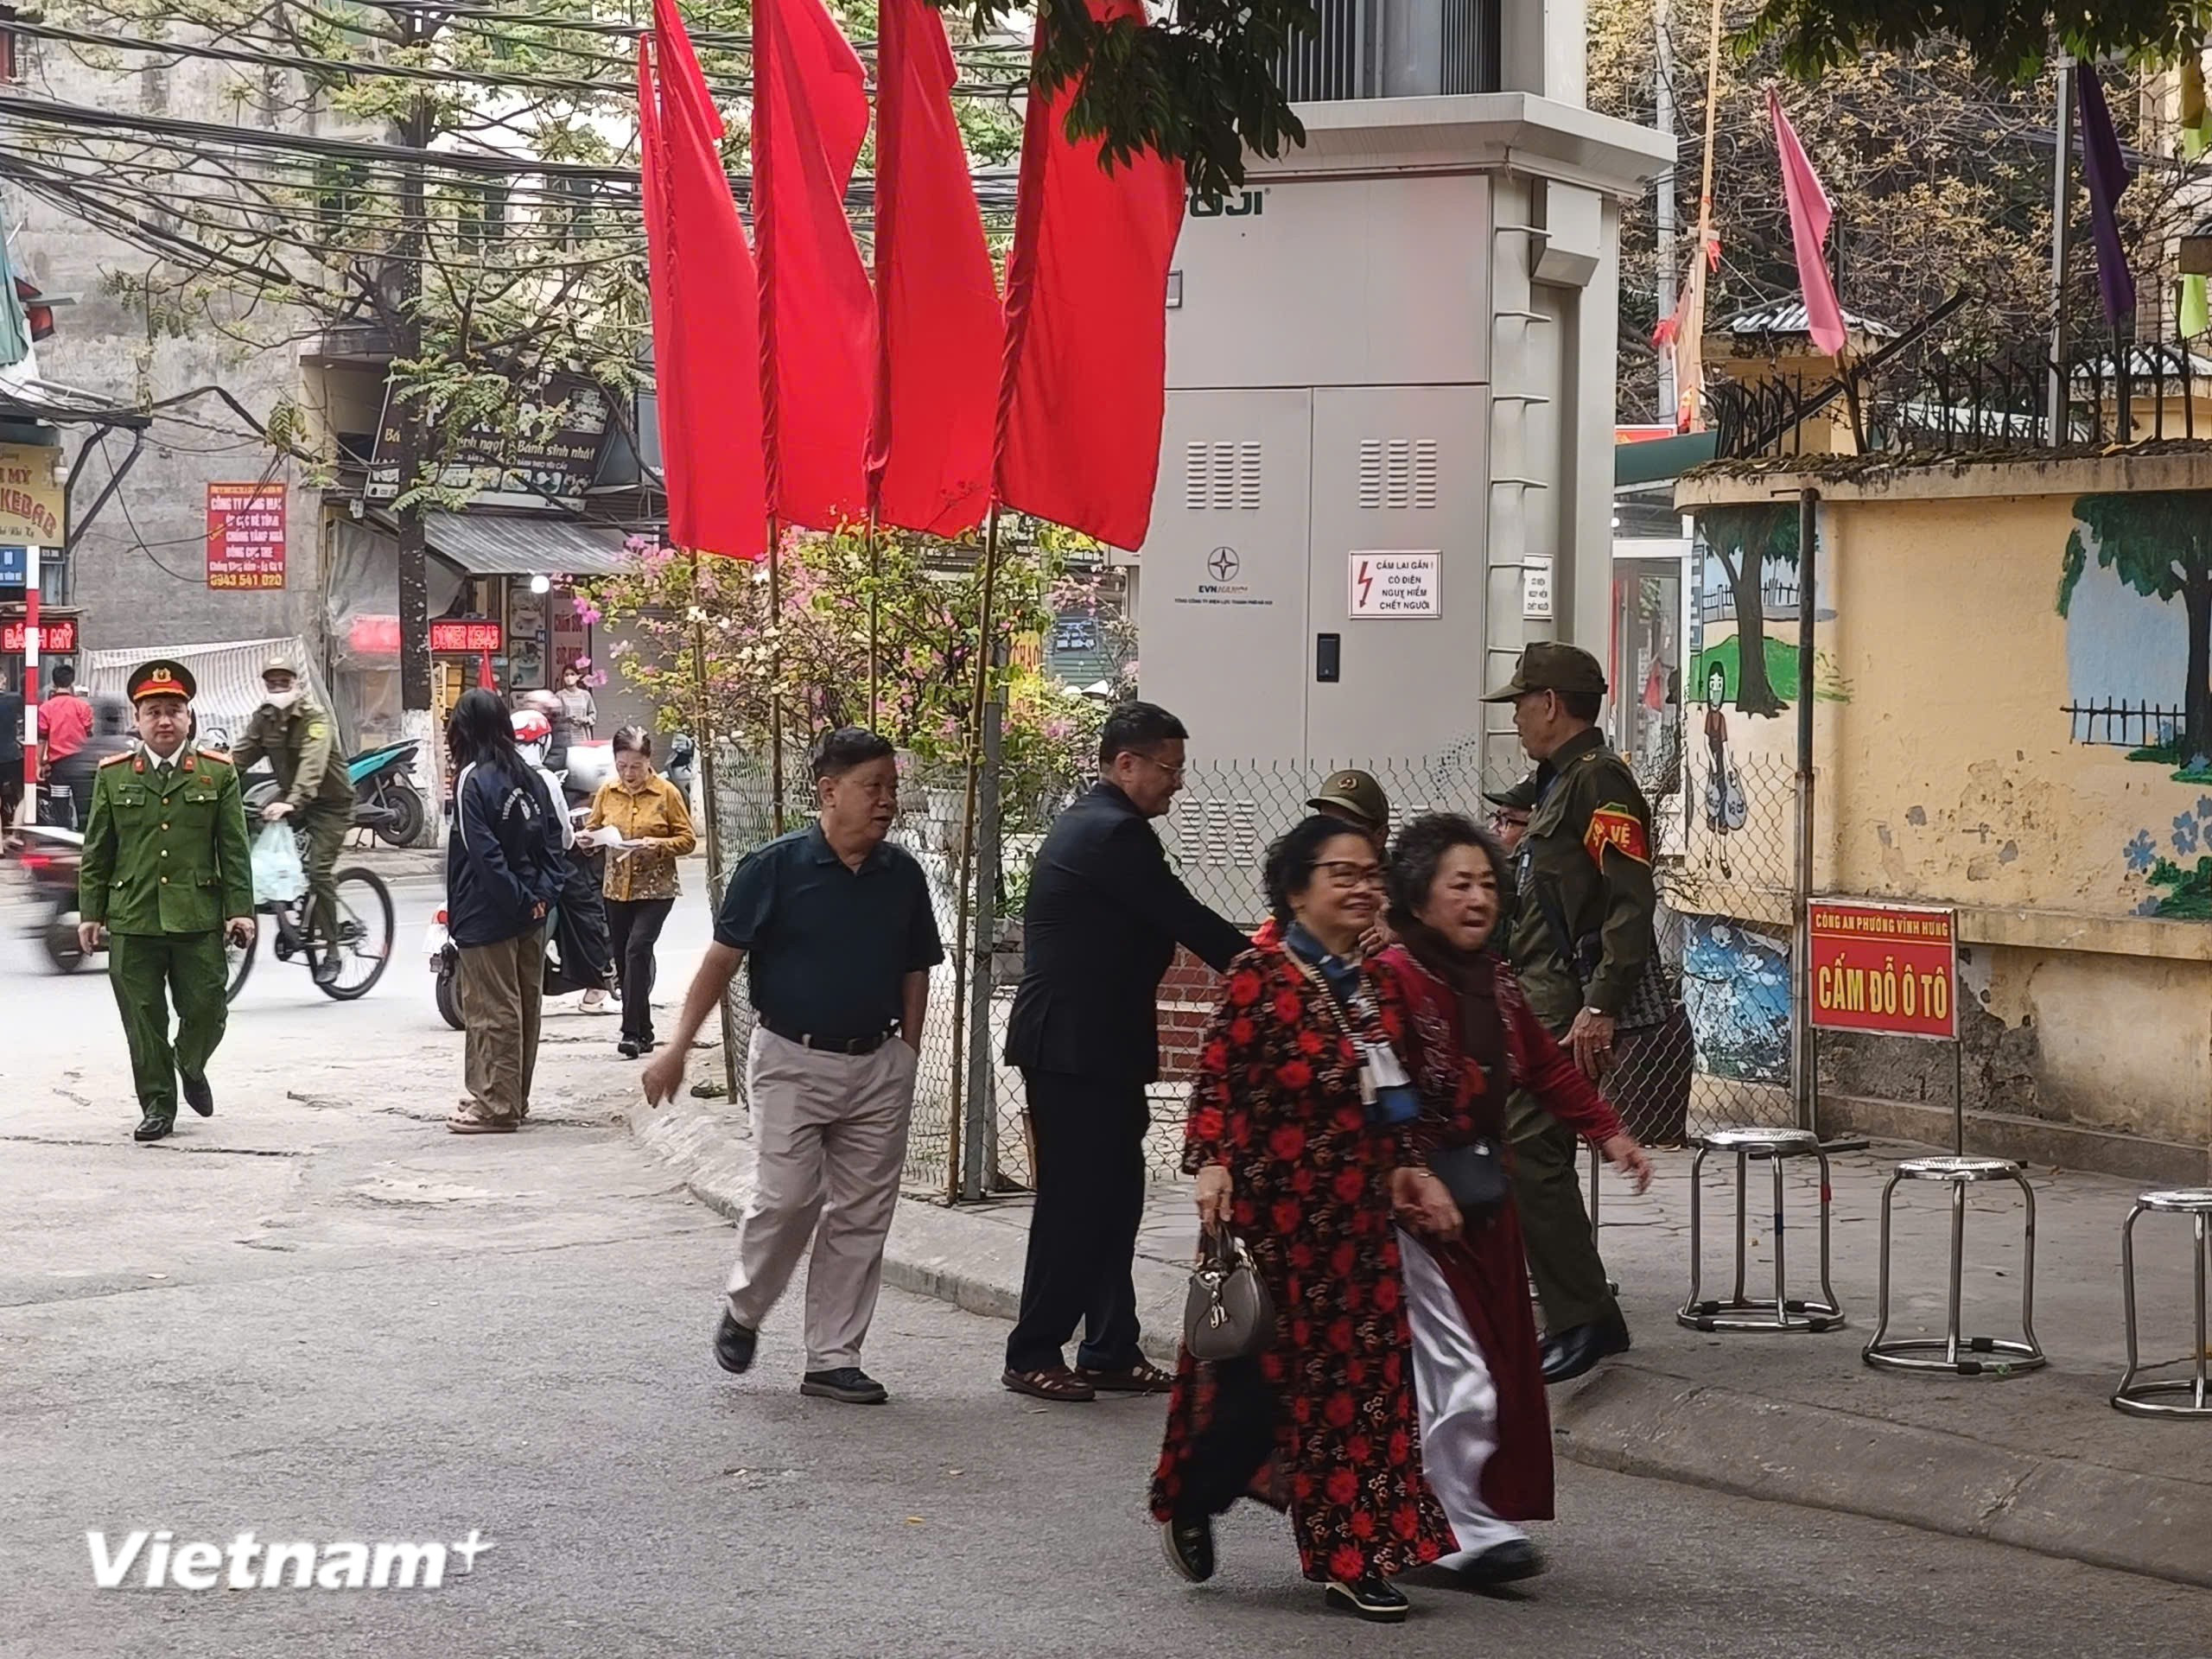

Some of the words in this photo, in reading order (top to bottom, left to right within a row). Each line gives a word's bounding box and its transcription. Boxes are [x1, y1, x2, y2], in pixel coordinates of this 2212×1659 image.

[1185, 191, 1262, 217] OJI
[518, 440, 544, 454] Bánh
[546, 443, 569, 457] sinh
[4, 622, 48, 650] BÁH
[1815, 912, 1840, 930] CÔNG
[1842, 915, 1855, 931] AN
[1857, 914, 1895, 933] PHƯỜNG
[1897, 917, 1920, 935] VĨNH
[1922, 920, 1948, 937] HƯNG
[1818, 951, 1866, 1012] CẤM
[1869, 956, 1897, 1015] ĐỖ
[1903, 963, 1916, 1016] Ô
[1921, 966, 1948, 1020] TÔ
